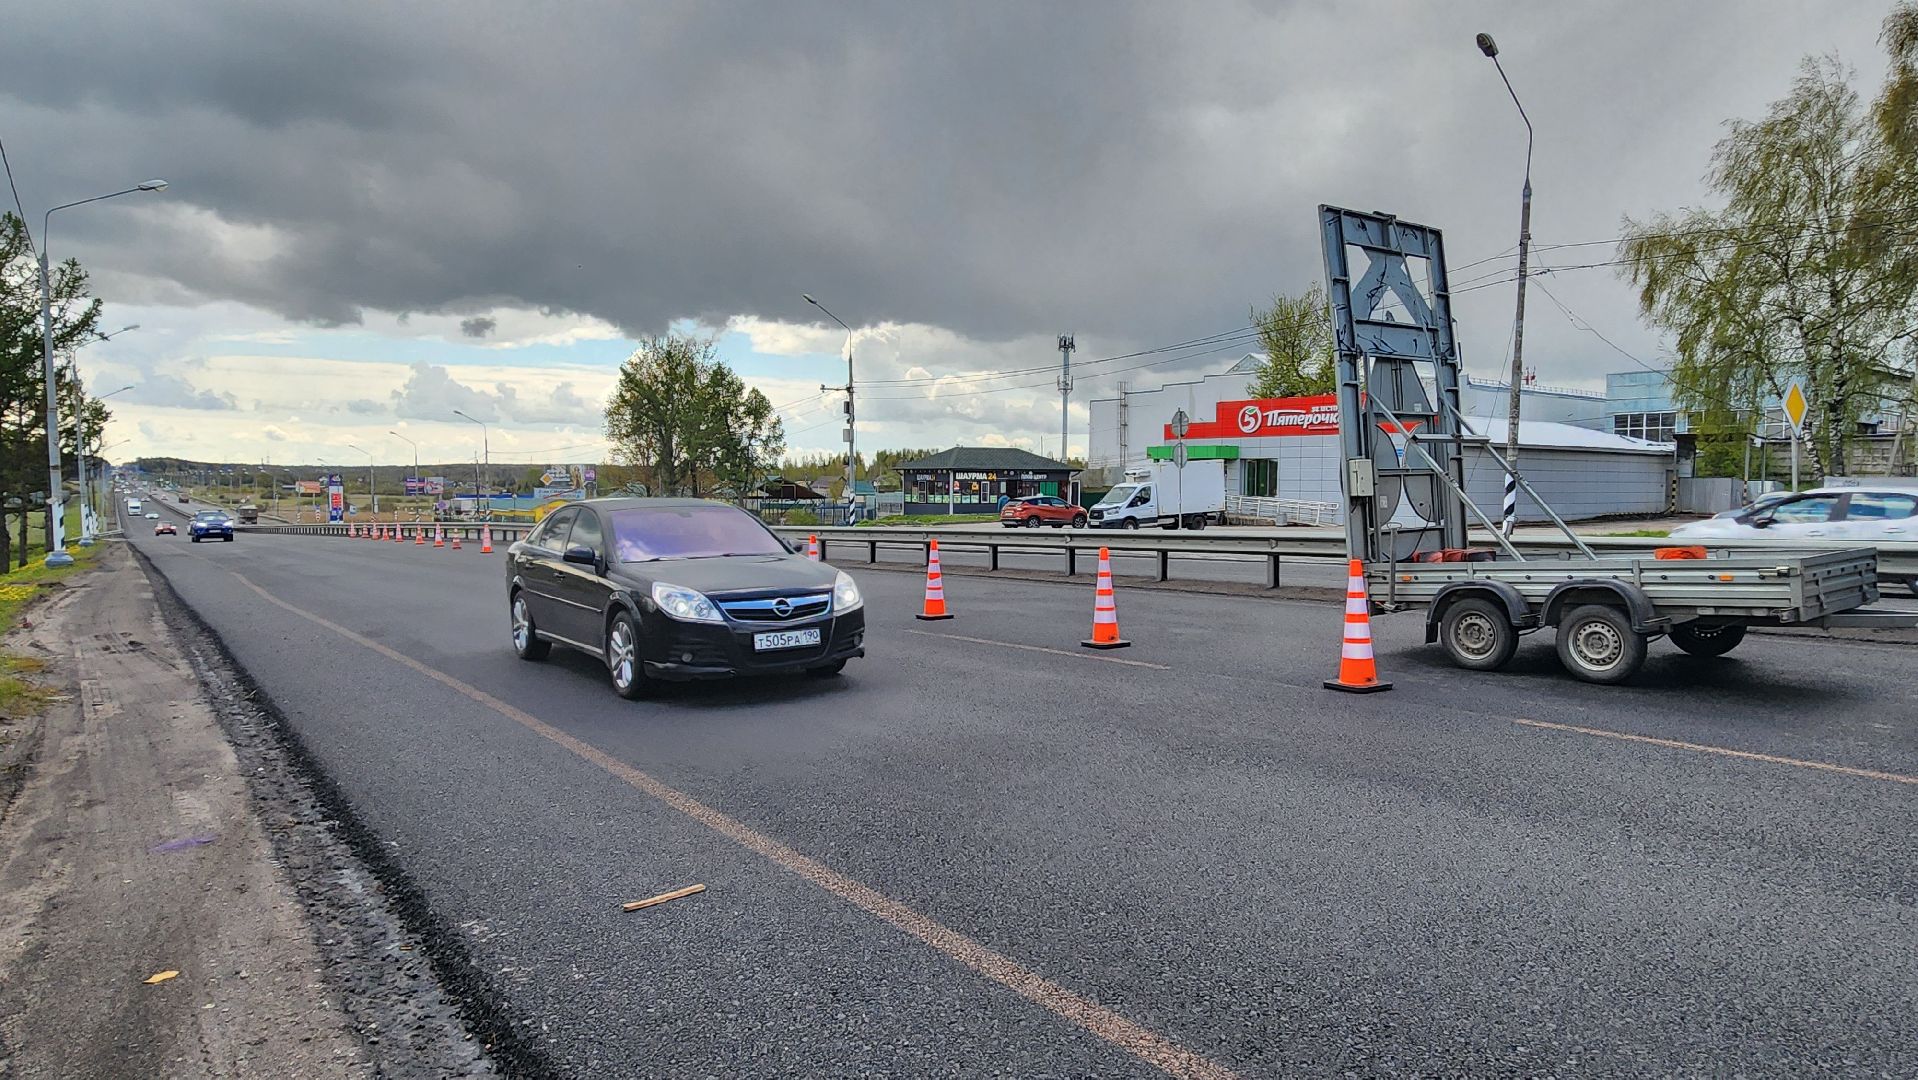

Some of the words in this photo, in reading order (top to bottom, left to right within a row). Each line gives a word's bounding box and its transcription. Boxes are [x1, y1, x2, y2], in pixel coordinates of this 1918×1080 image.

[1263, 409, 1340, 429] Пятерочк
[955, 472, 987, 480] ШАУРМА
[987, 472, 997, 481] 24
[803, 630, 818, 640] 190
